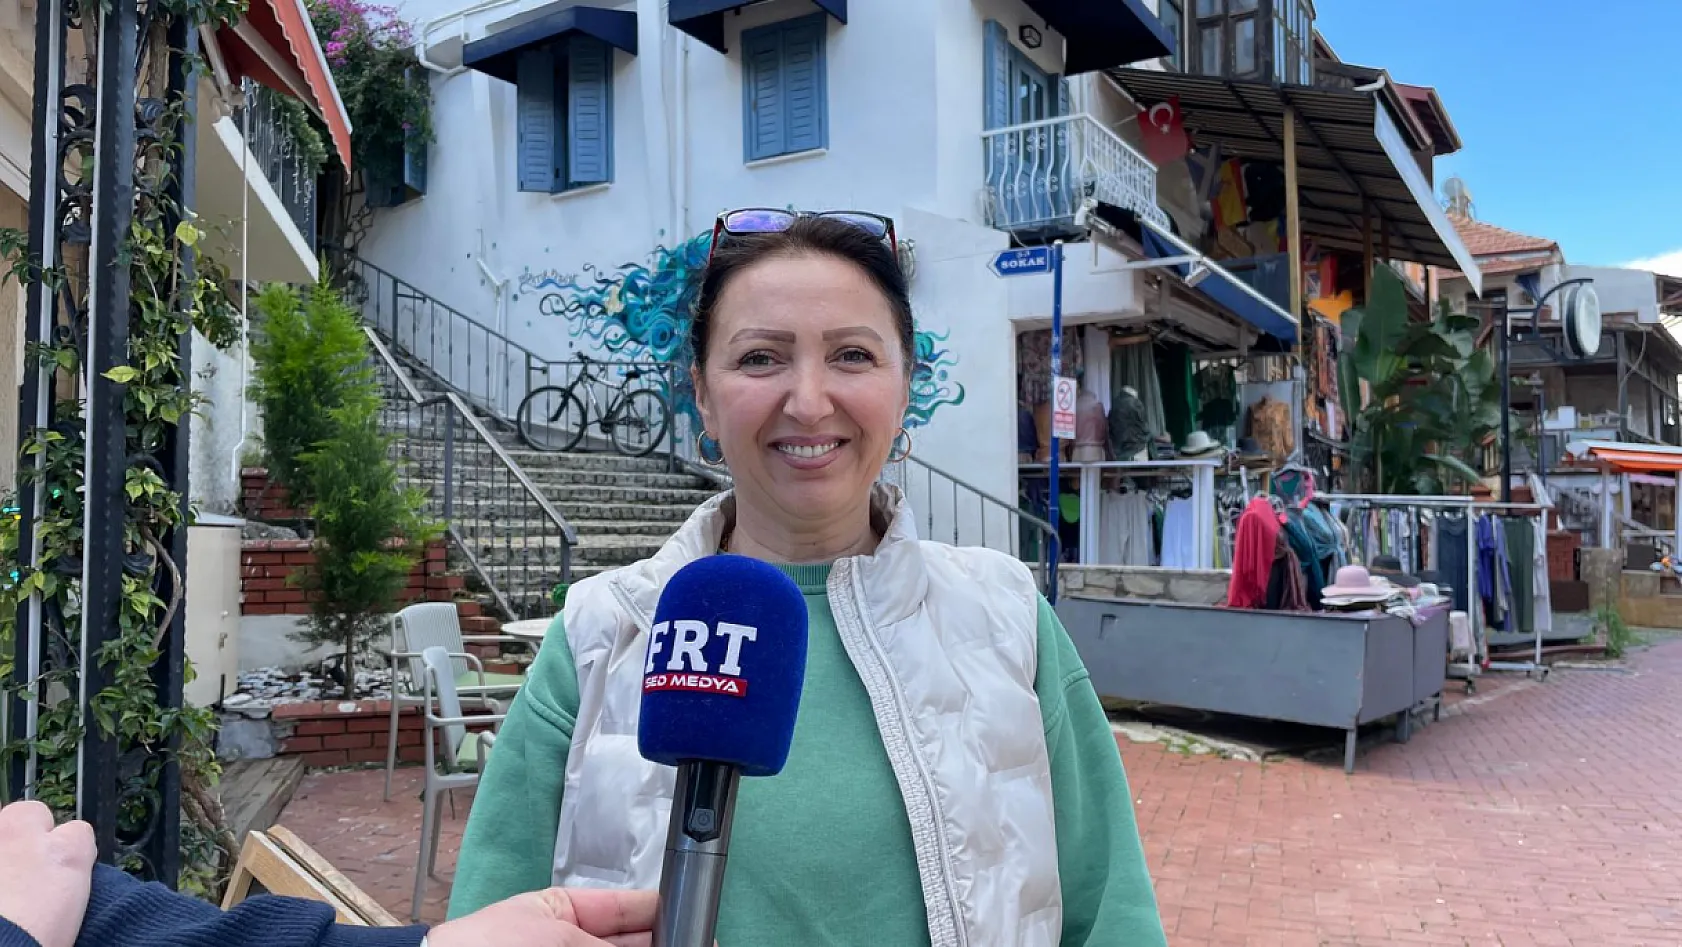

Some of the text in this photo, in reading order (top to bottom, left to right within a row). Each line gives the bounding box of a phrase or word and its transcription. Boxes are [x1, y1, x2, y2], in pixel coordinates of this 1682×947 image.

[1001, 257, 1044, 269] SOKAK
[645, 620, 758, 676] FRT
[670, 675, 739, 693] MEDYA
